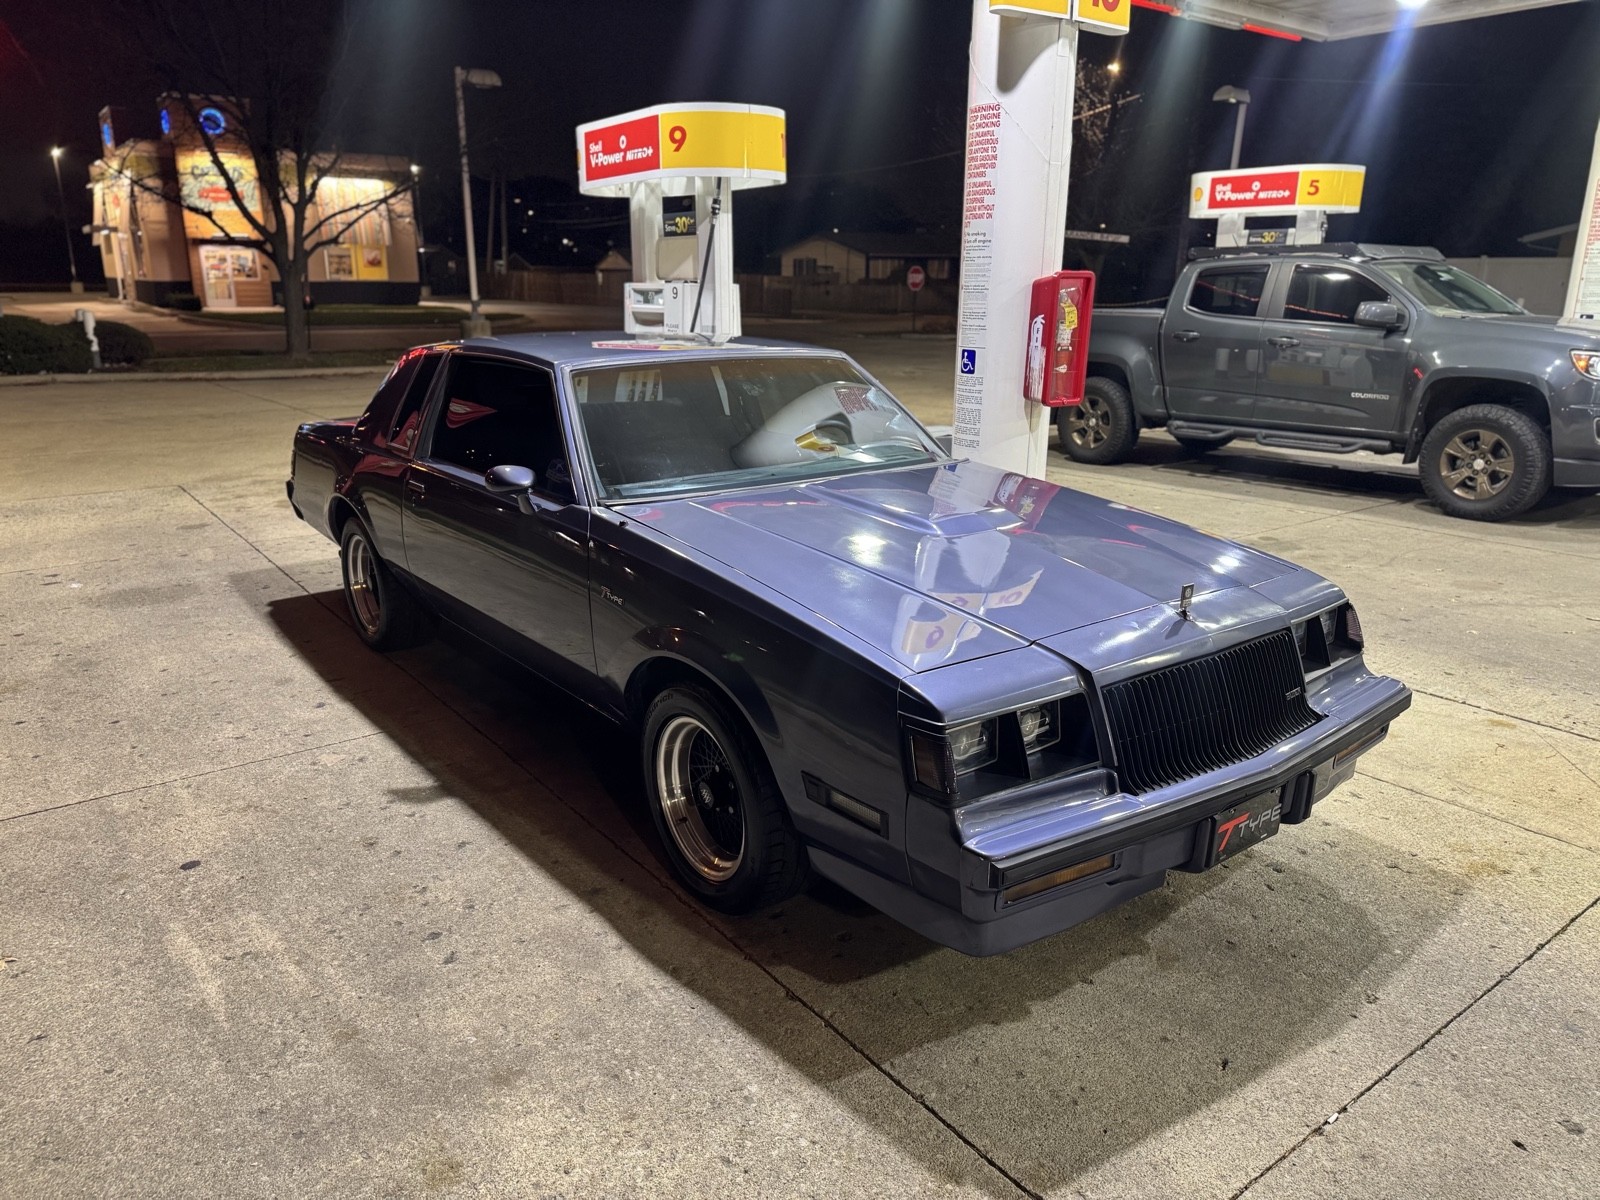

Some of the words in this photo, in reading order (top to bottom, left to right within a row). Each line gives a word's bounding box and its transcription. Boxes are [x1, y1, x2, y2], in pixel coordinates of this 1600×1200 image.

[980, 112, 1001, 121] ENGINE
[976, 120, 1000, 130] SMOKING
[668, 126, 687, 152] 9
[974, 137, 999, 146] DANGEROUS
[589, 140, 602, 154] Shell
[973, 146, 990, 154] ANYONE
[590, 152, 624, 168] V-Power
[979, 154, 998, 162] GASOLINE
[1307, 179, 1320, 196] 5
[1216, 191, 1256, 201] V-Power
[978, 204, 994, 212] WITHOUT
[674, 216, 688, 234] 30
[1261, 232, 1276, 244] 30
[672, 286, 678, 300] 9
[1351, 392, 1390, 400] COLORADO
[1239, 803, 1282, 838] TYPE
